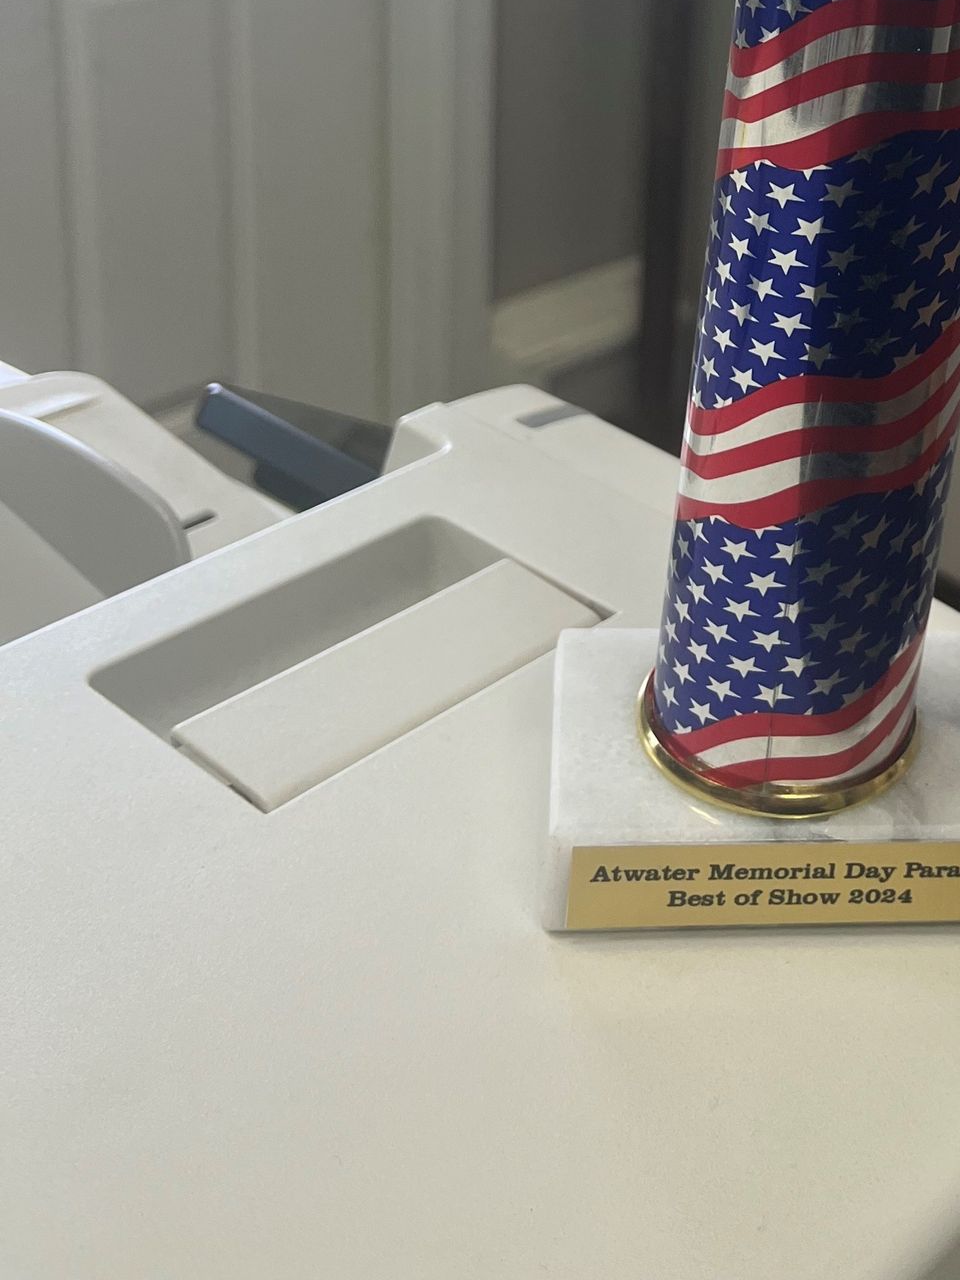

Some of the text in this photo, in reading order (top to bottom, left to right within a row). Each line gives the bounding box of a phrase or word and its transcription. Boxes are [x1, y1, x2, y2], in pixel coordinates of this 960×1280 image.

[589, 865, 701, 883] Atwater
[707, 862, 836, 881] Memorial
[843, 862, 897, 884] Day
[666, 888, 913, 908] Best of Show 2024
